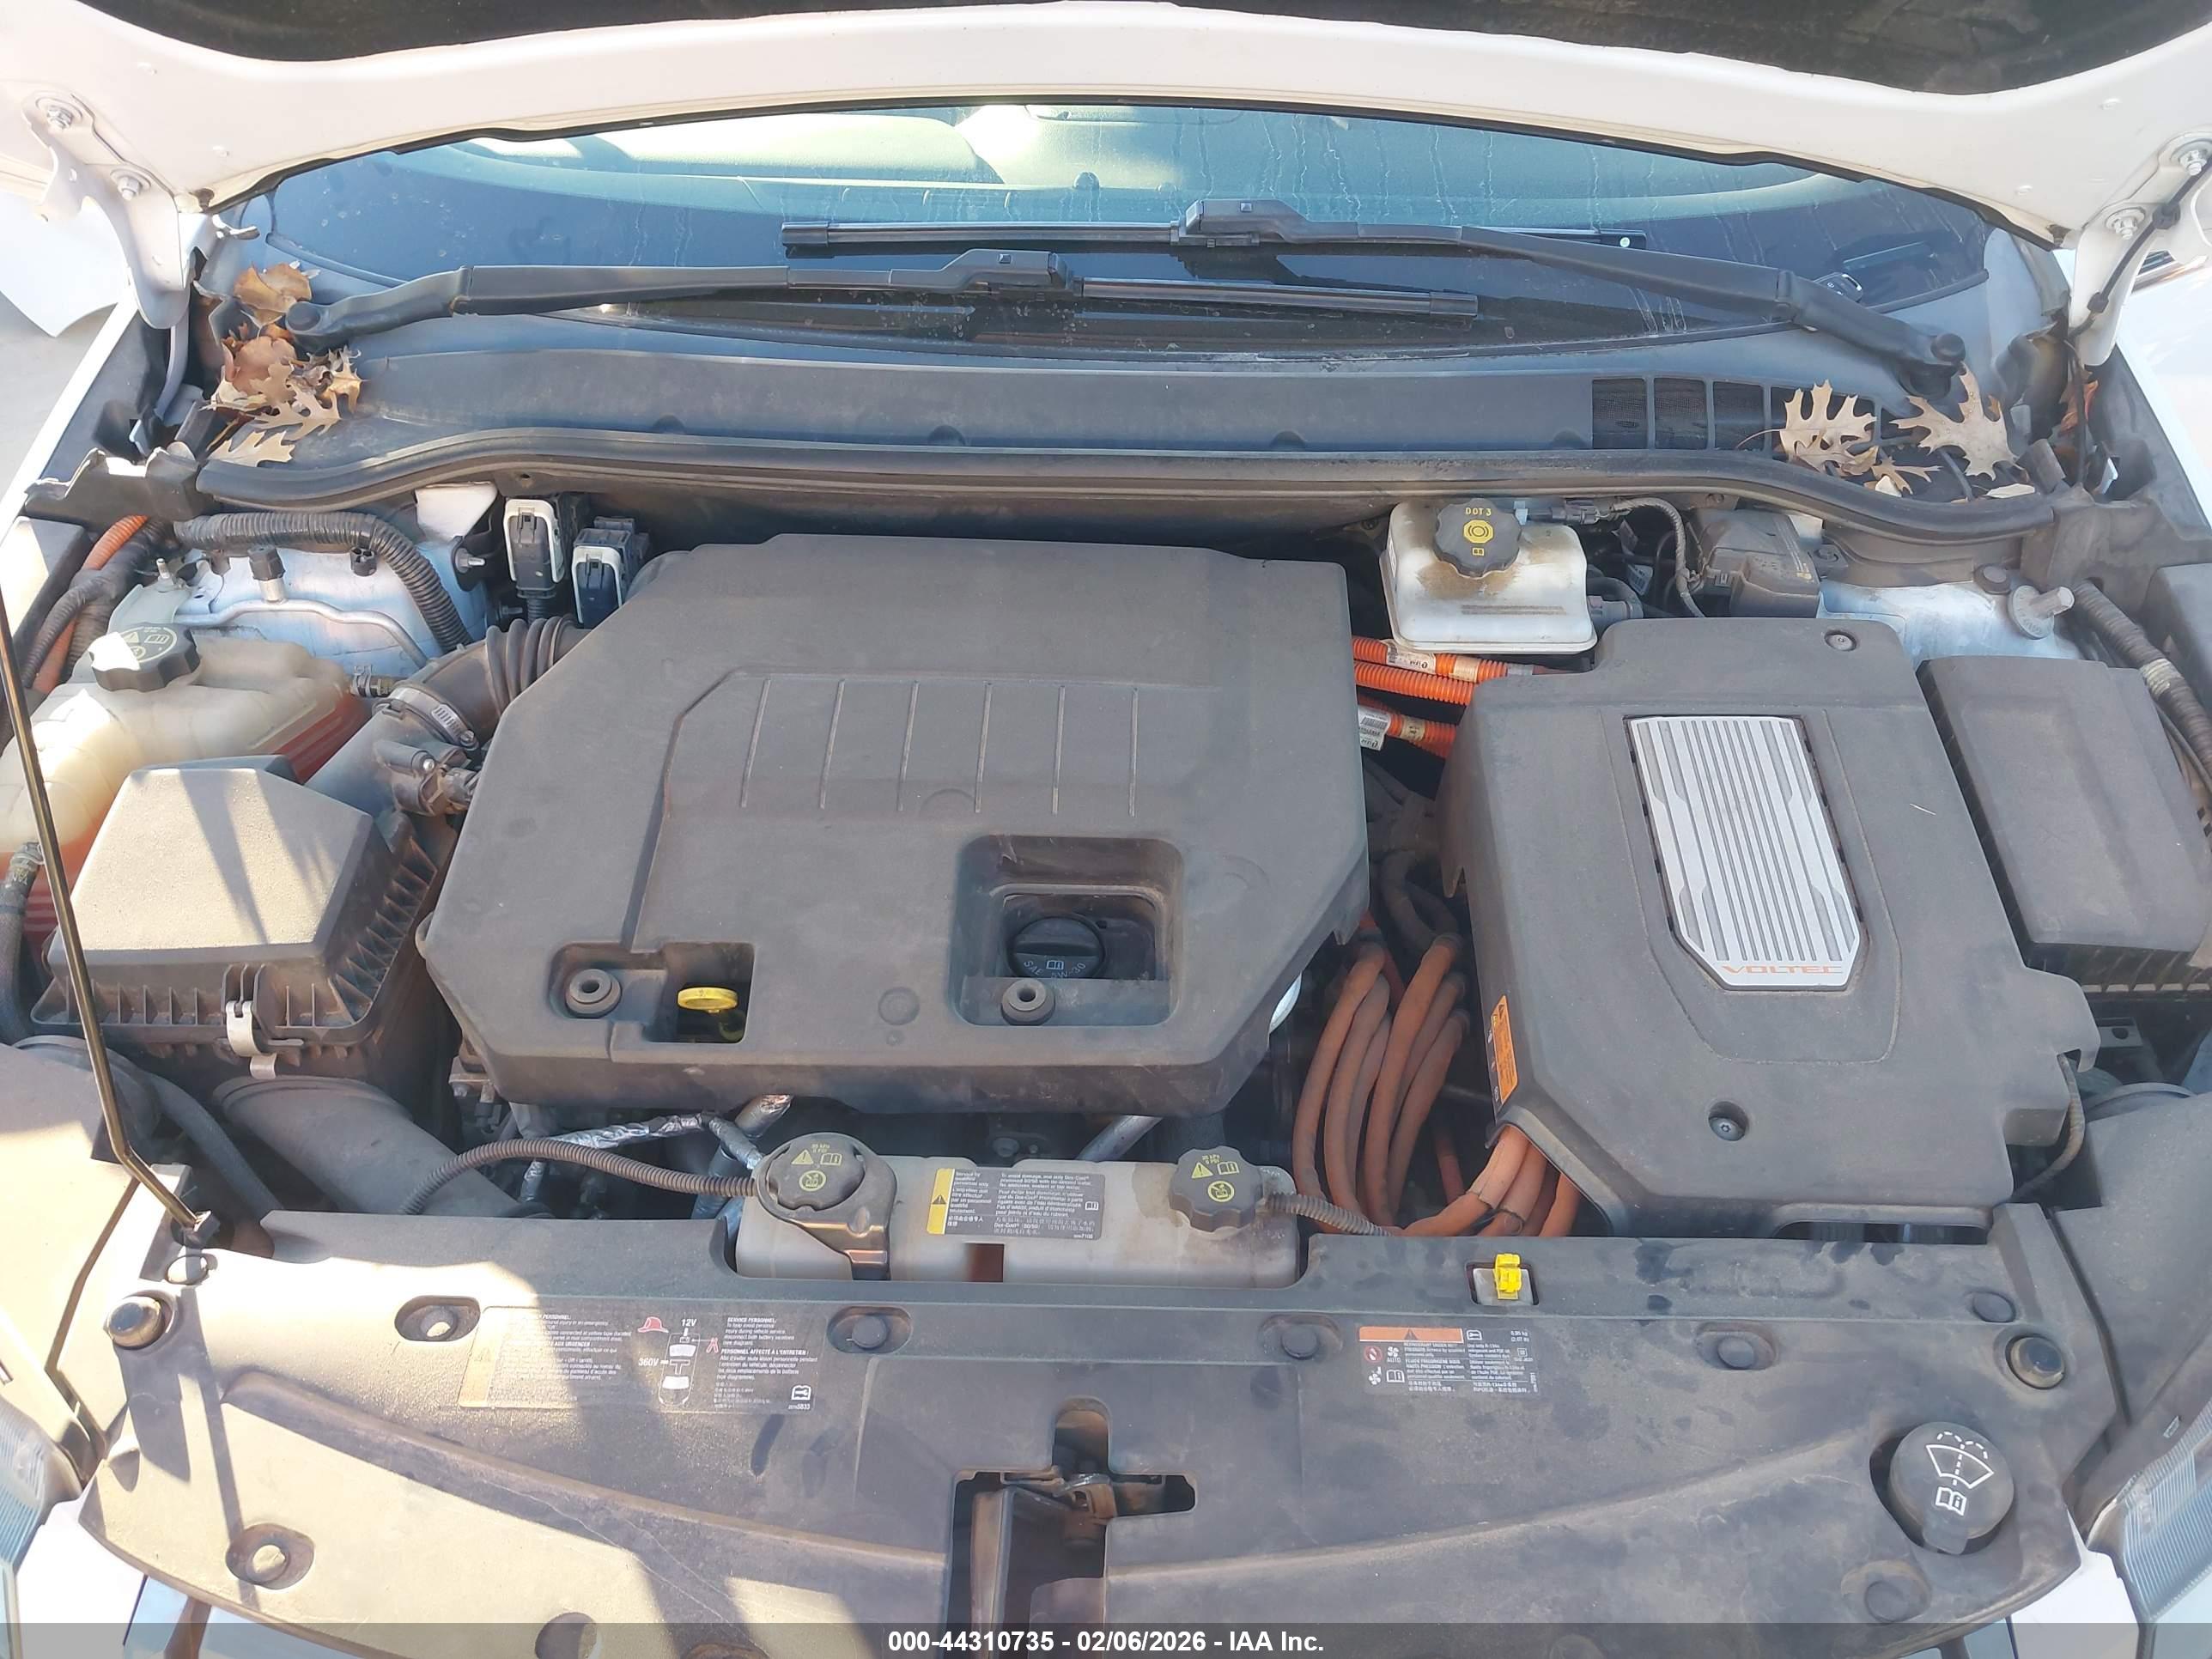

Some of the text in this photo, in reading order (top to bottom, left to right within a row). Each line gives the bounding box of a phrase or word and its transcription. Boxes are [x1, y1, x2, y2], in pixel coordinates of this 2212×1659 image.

[1465, 507, 1484, 515] DOT
[1024, 960, 1044, 975] SAE
[1722, 965, 1843, 974] VOLTEC
[638, 1358, 659, 1366] 360V
